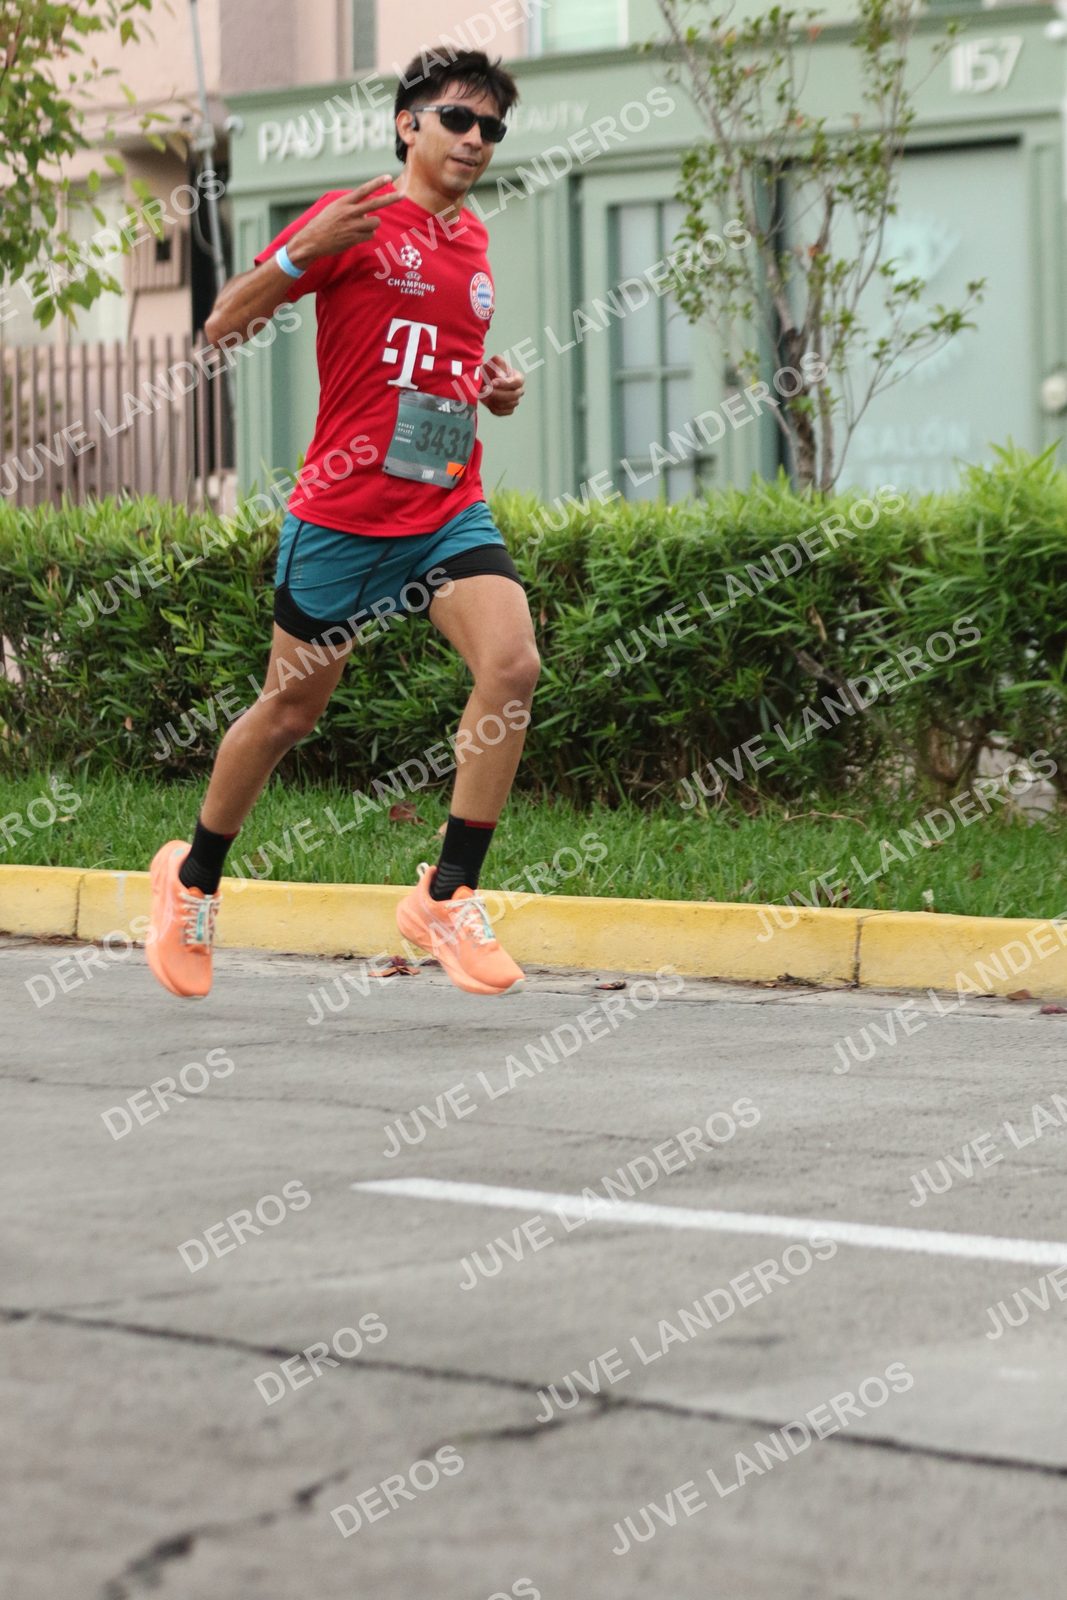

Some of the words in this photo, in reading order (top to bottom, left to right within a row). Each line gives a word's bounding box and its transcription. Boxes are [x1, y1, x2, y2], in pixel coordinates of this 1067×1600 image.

[950, 35, 1023, 93] 157
[334, 109, 398, 154] BRI
[502, 99, 591, 137] EAUTY
[388, 278, 435, 293] CHAMPIONS
[400, 287, 424, 296] LEAGUE
[415, 420, 472, 463] 3431
